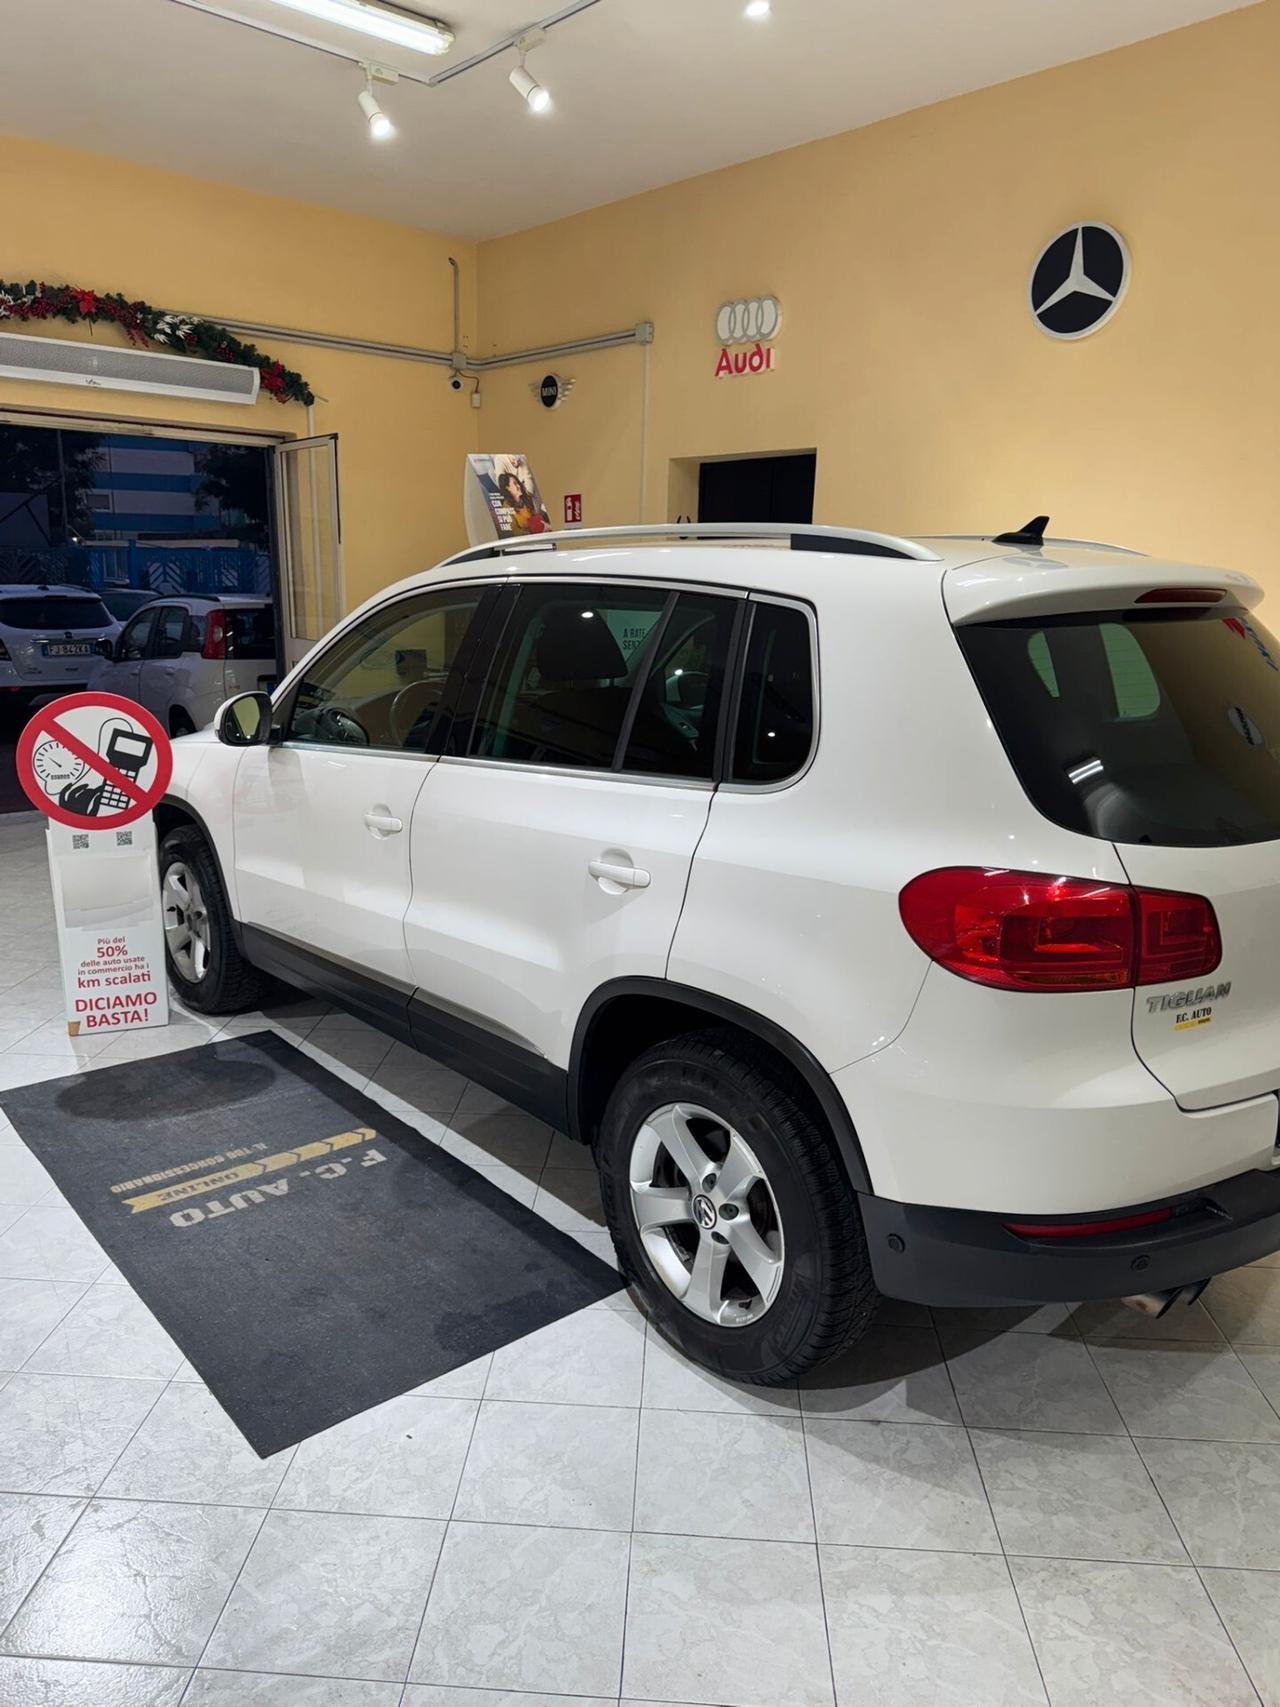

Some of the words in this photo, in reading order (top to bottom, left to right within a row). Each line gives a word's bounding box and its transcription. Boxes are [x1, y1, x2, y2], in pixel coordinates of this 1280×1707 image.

[714, 343, 771, 376] Audi
[542, 386, 557, 397] MINI
[623, 628, 629, 639] A
[112, 936, 126, 944] del
[97, 945, 128, 958] 50%
[78, 968, 86, 976] in
[87, 965, 133, 975] commercio
[80, 960, 101, 968] delle
[102, 958, 122, 966] auto
[123, 956, 145, 964] usate
[78, 977, 101, 988] km
[105, 970, 151, 986] scalati
[75, 992, 157, 1012] DICIAMO
[1146, 981, 1232, 1014] TIGUAN
[86, 1008, 149, 1028] BASTA!
[1191, 1007, 1212, 1020] AUTO
[110, 1155, 225, 1194] CONCESSIONARIO
[158, 1171, 240, 1201] ONLINE
[169, 1178, 289, 1228] AUTO
